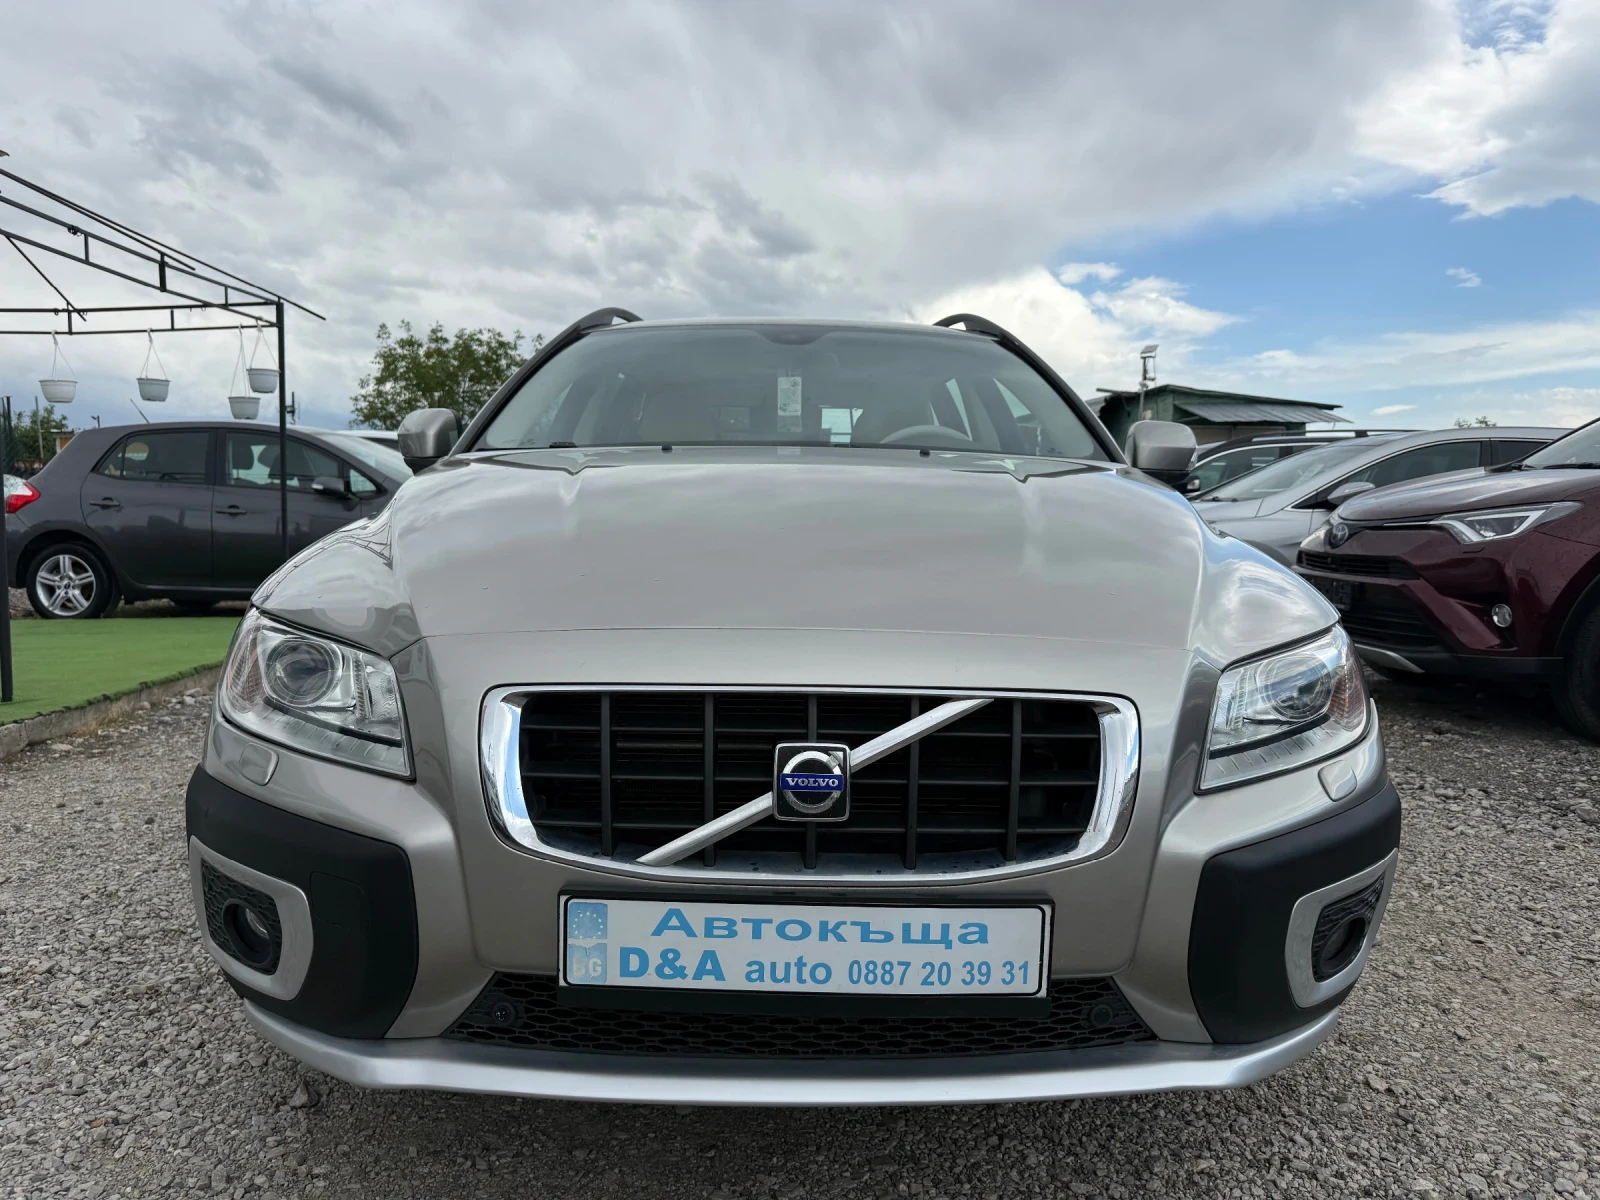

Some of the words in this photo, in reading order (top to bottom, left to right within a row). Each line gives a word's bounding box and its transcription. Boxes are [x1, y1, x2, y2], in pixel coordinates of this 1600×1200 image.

[784, 777, 839, 787] VOLVO
[651, 908, 988, 949] Автокъща
[619, 946, 725, 982] D&A
[745, 955, 832, 983] auto
[848, 959, 911, 985] 0887
[920, 961, 952, 987] 20
[961, 961, 992, 987] 39
[1001, 960, 1029, 986] 31
